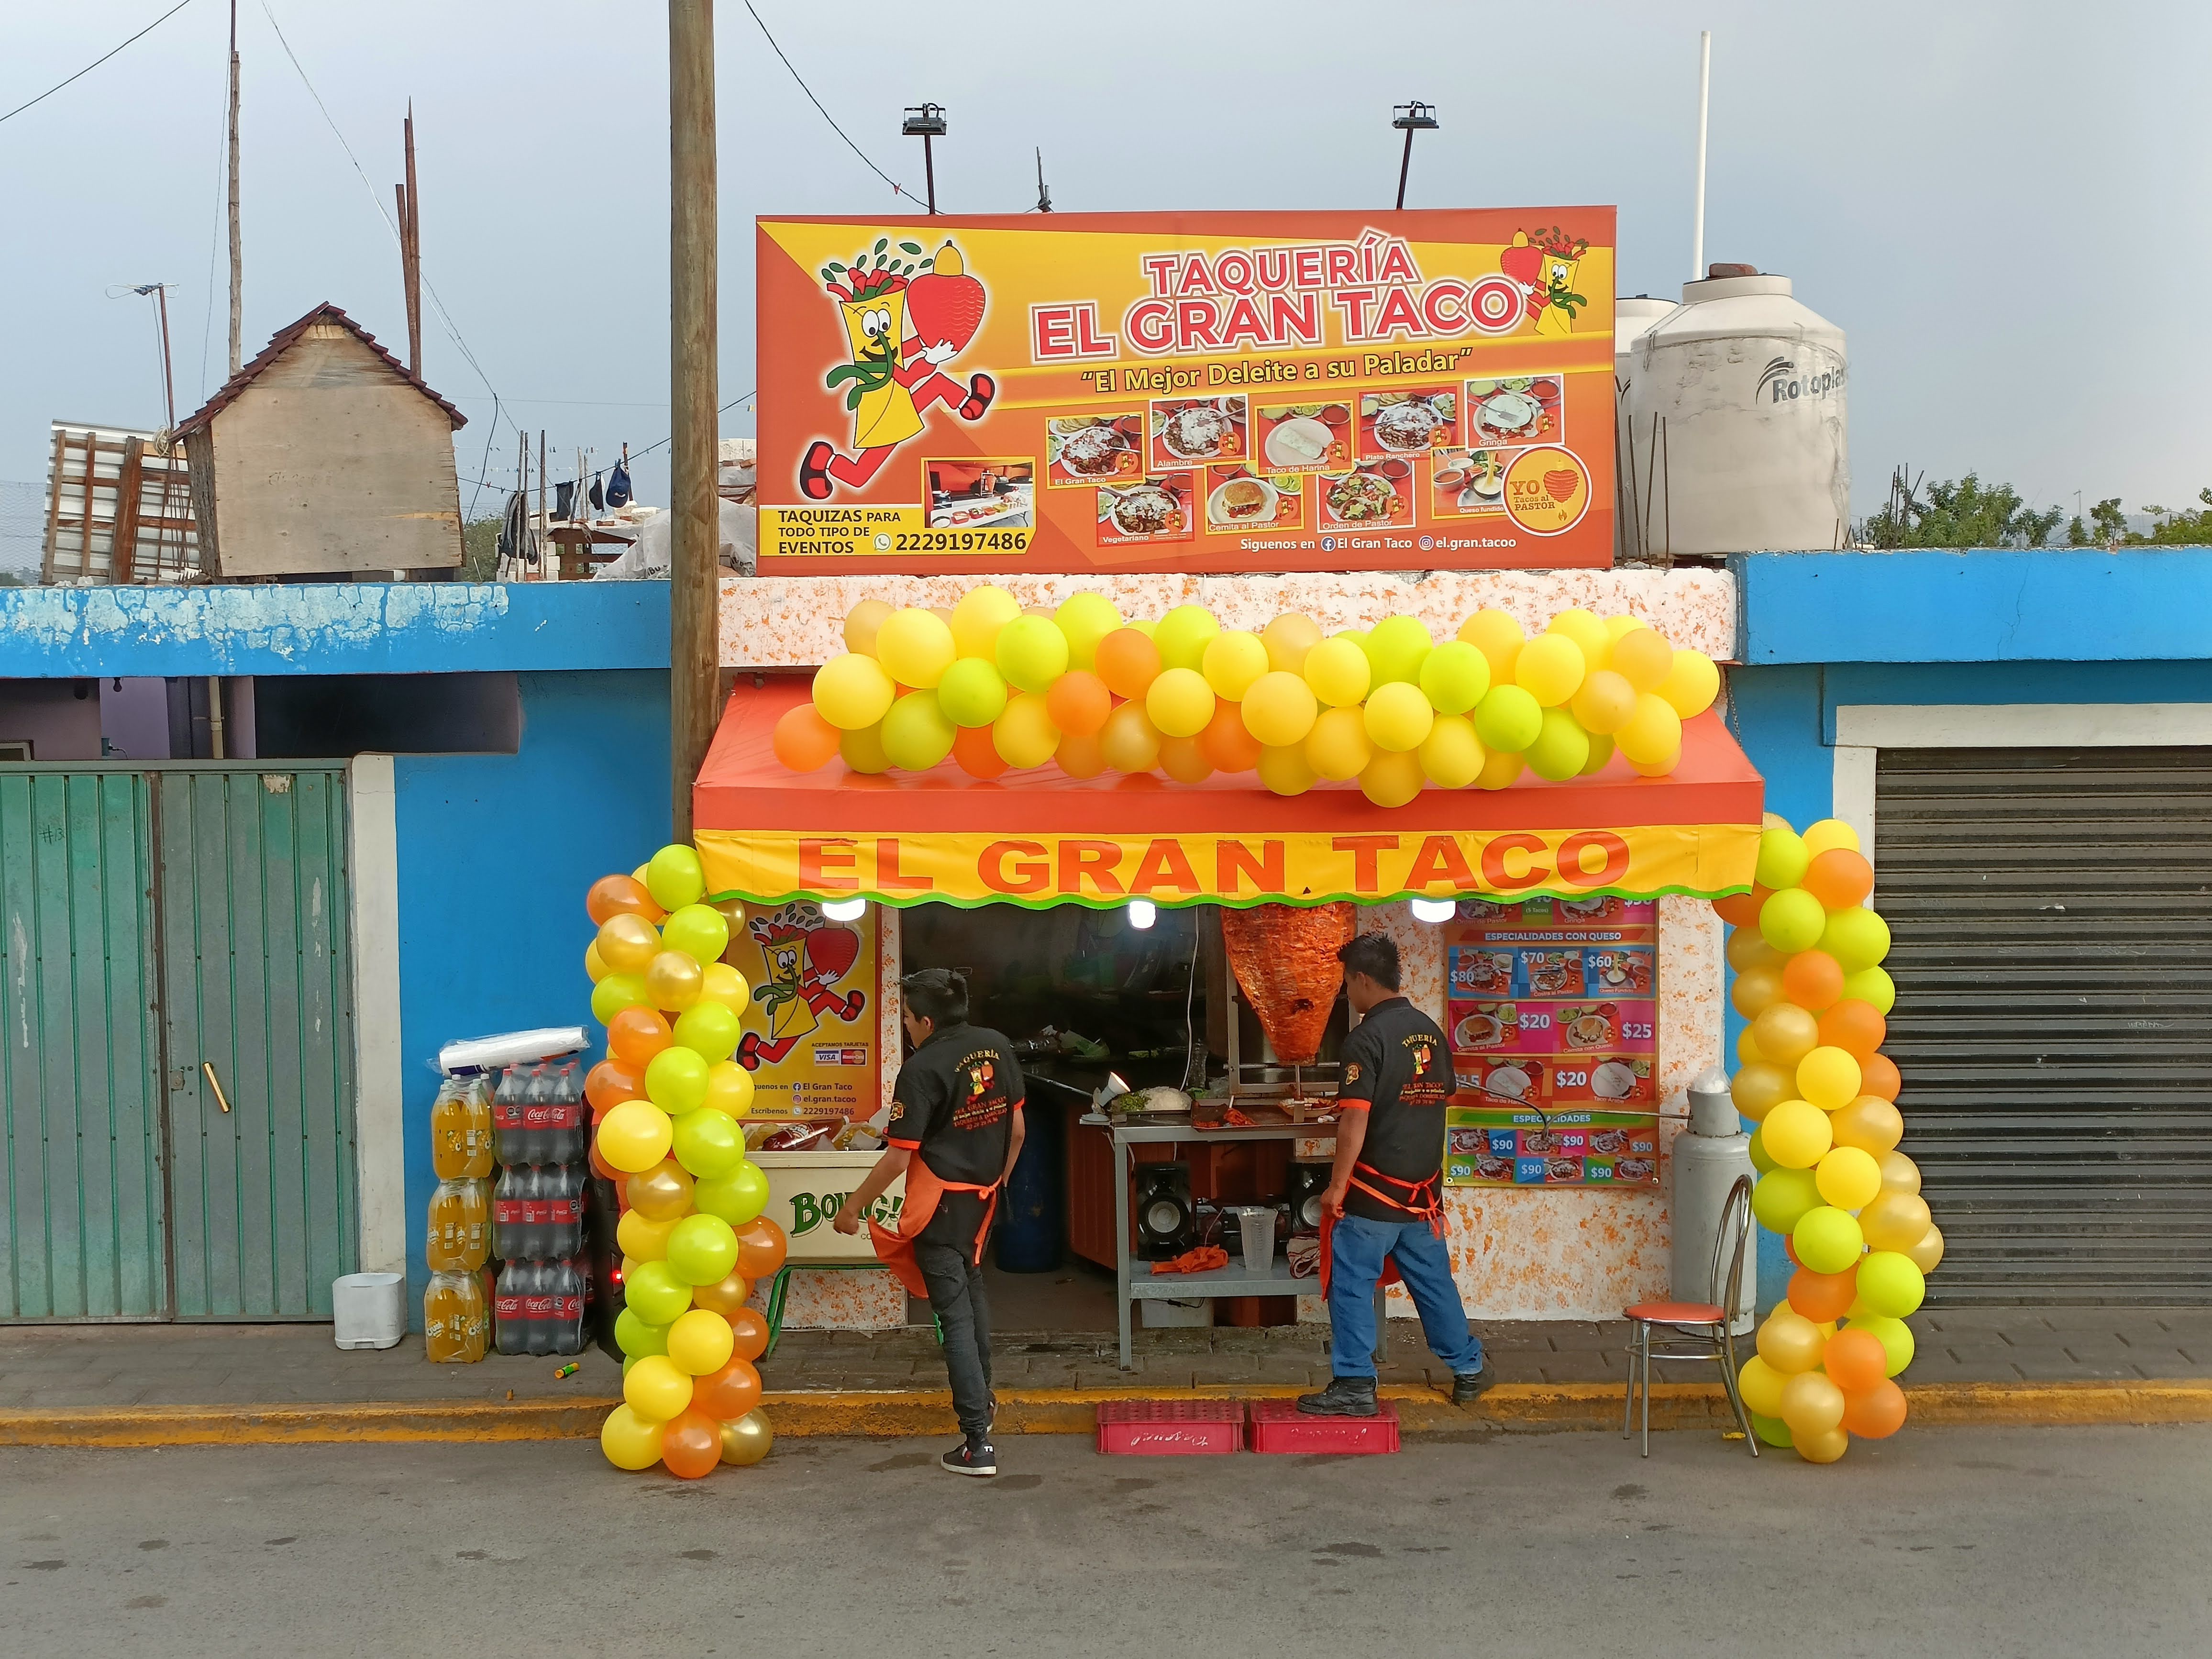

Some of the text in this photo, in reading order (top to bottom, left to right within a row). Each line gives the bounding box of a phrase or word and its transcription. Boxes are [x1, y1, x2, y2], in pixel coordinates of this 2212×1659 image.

[1146, 226, 1421, 297] TAQUERÍA
[1030, 277, 1528, 362] EL GRAN TACO
[1124, 368, 1201, 395] Mejor
[1209, 360, 1297, 386] Deleite
[1304, 365, 1319, 381] a
[1327, 361, 1354, 379] su
[1479, 438, 1507, 447] Gringa
[1302, 463, 1330, 472] Harina
[1510, 480, 1540, 495] YO
[1515, 501, 1555, 511] PASTOR
[778, 509, 901, 525] TAQUIZAS PARA
[1365, 519, 1393, 527] Pastor
[1252, 521, 1279, 529] Pastor
[778, 527, 870, 537] TODO TIPO DE
[896, 532, 1027, 551] 2229197486
[1103, 535, 1149, 543] Vegetariano
[1240, 536, 1517, 552] Siguenos en El Gran Taco el.gran.tacoo
[779, 541, 854, 554] EVENTOS
[799, 830, 1630, 894] EL GRAN TACO
[1485, 932, 1622, 941] ESPECIALIDADES CON QUESO
[1521, 951, 1545, 964] $70
[1588, 955, 1612, 969] $60
[1450, 970, 1474, 984] $80
[1520, 1013, 1550, 1030] $20
[1622, 1022, 1652, 1039] $25
[1557, 1071, 1587, 1088] $20
[803, 1095, 856, 1104] el.gran.tacoo
[1514, 1115, 1591, 1123] ESPECAIDADES
[1492, 1139, 1513, 1150] $90
[1563, 1135, 1583, 1147] $90
[1632, 1141, 1653, 1152] $90
[1450, 1165, 1471, 1176] $90
[1521, 1163, 1542, 1175] $90
[1591, 1166, 1612, 1178] $90
[789, 1192, 903, 1238] BOG!
[496, 1298, 519, 1311] ca-Cola
